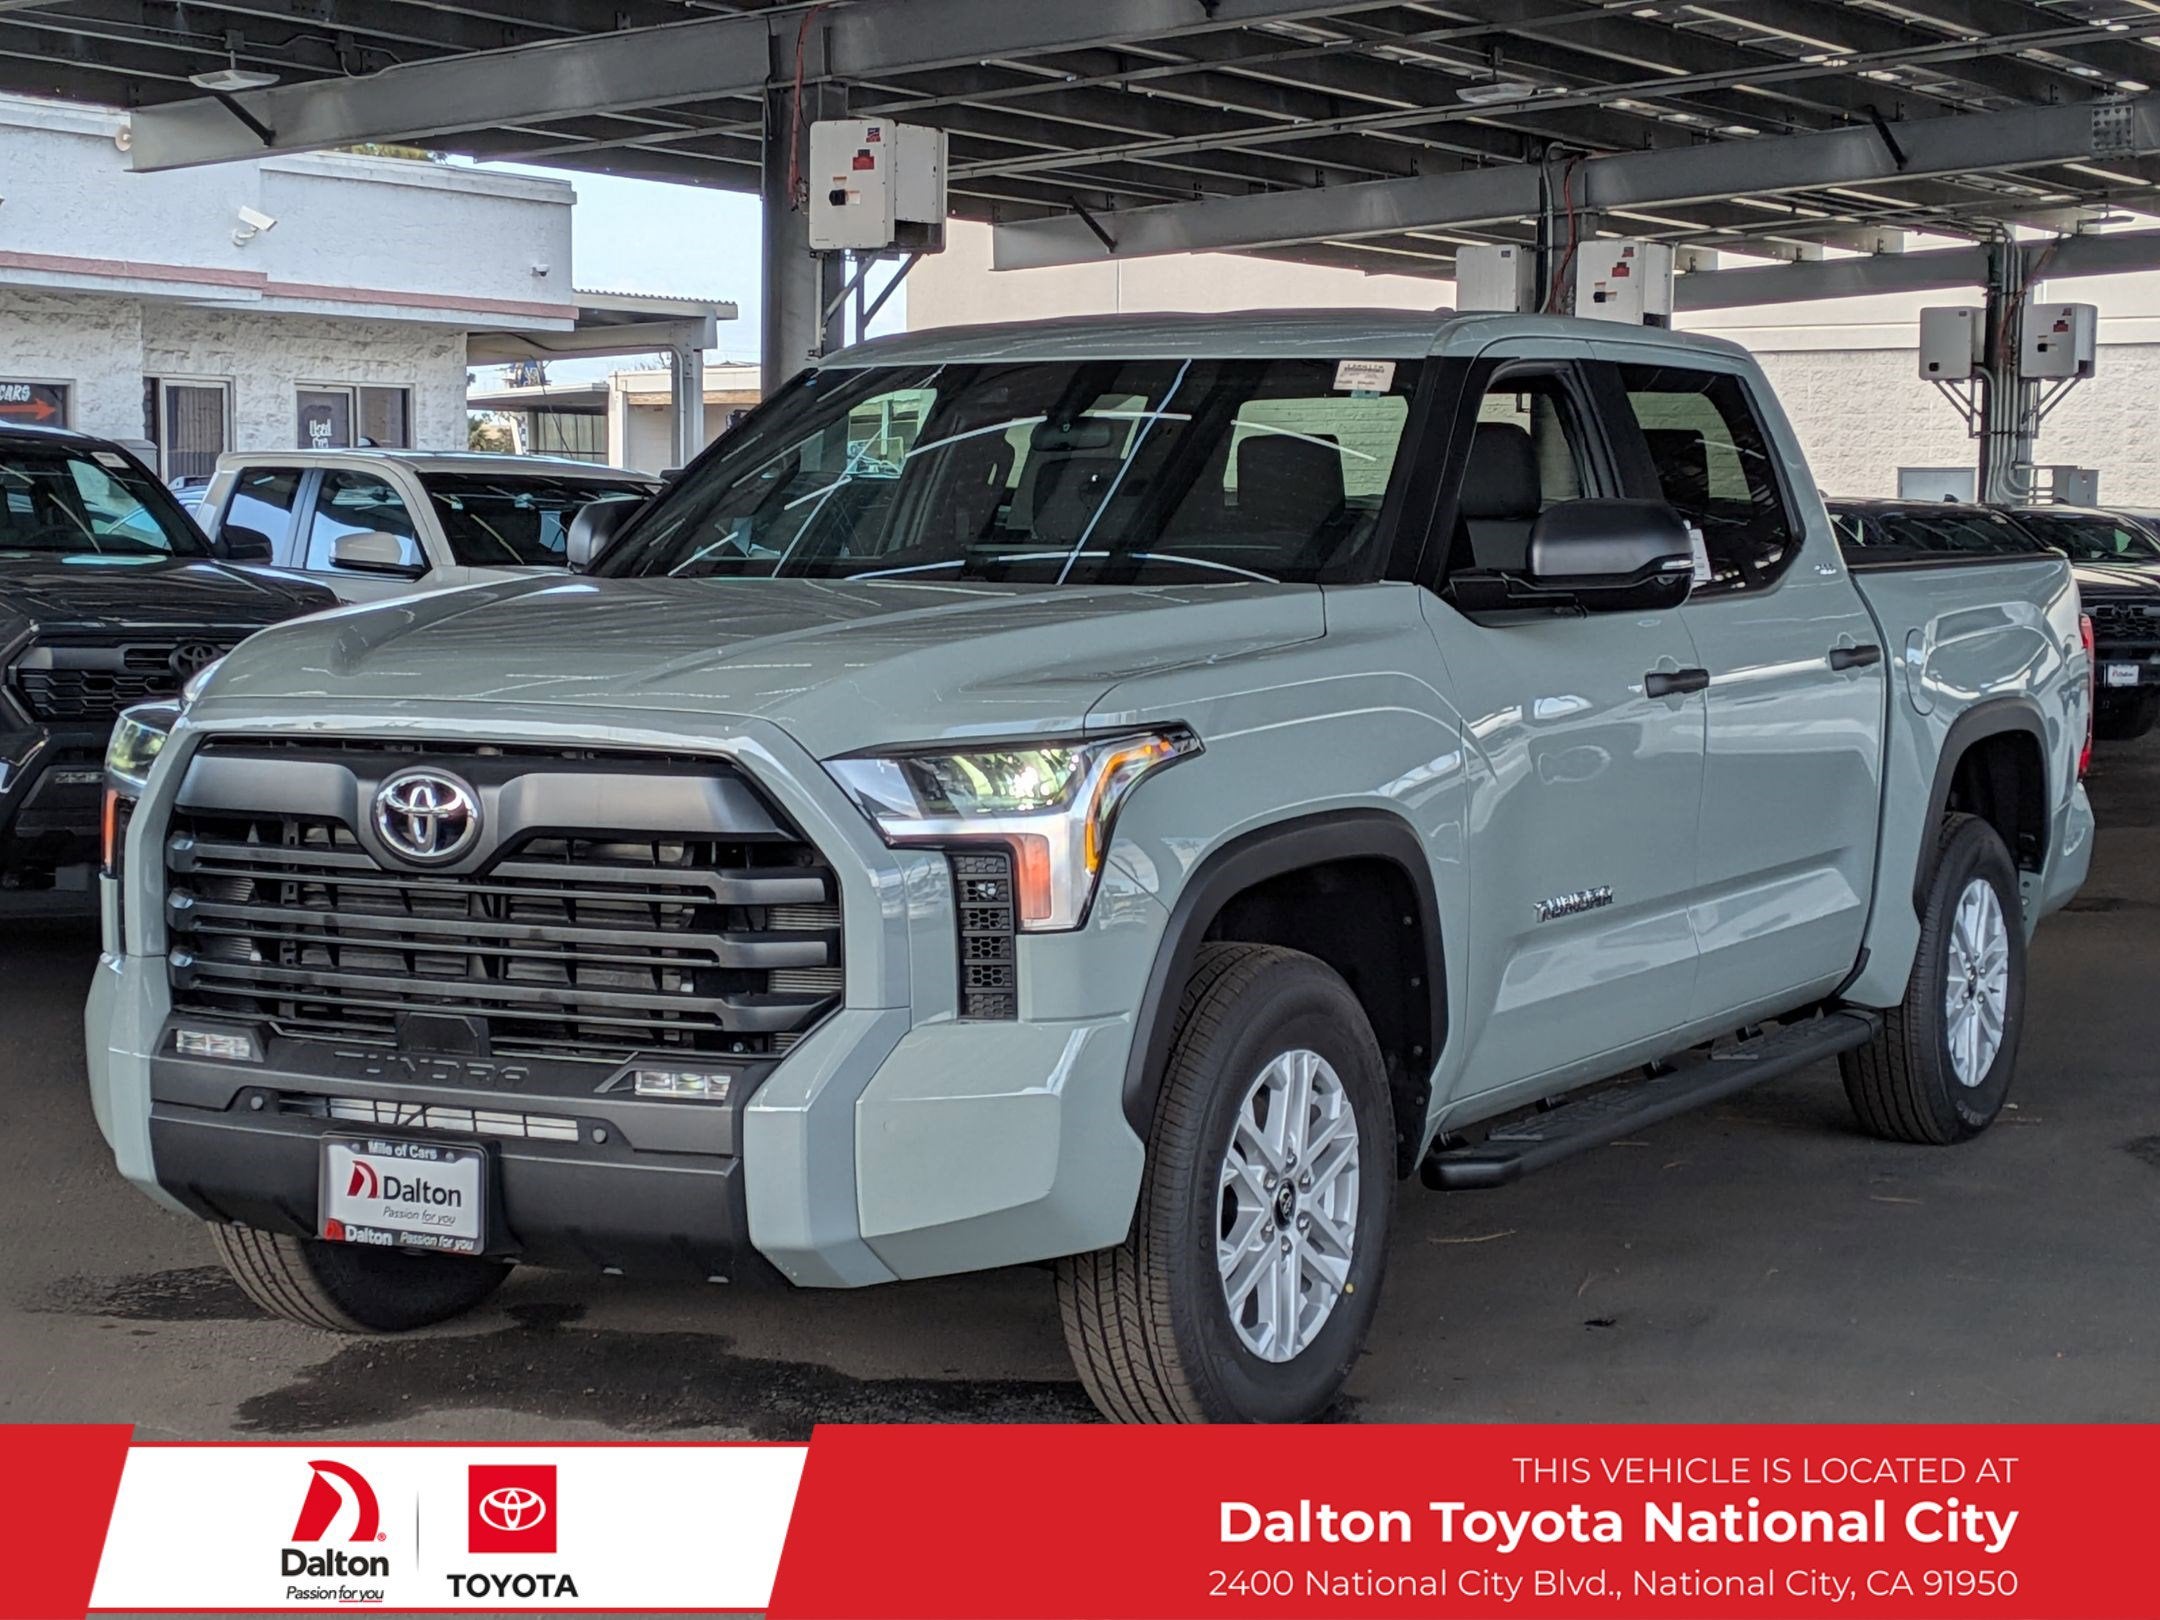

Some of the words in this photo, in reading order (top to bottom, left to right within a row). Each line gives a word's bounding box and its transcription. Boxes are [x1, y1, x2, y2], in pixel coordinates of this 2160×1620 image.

[367, 1140, 392, 1156] Mile
[394, 1144, 407, 1157] of
[409, 1146, 438, 1160] Cars
[383, 1175, 462, 1208] Dalton
[383, 1206, 420, 1220] Passion
[422, 1209, 435, 1222] for
[437, 1215, 457, 1226] you
[345, 1225, 393, 1247] Dalton
[401, 1231, 437, 1247] Passion
[438, 1236, 454, 1248] for
[455, 1239, 475, 1252] you
